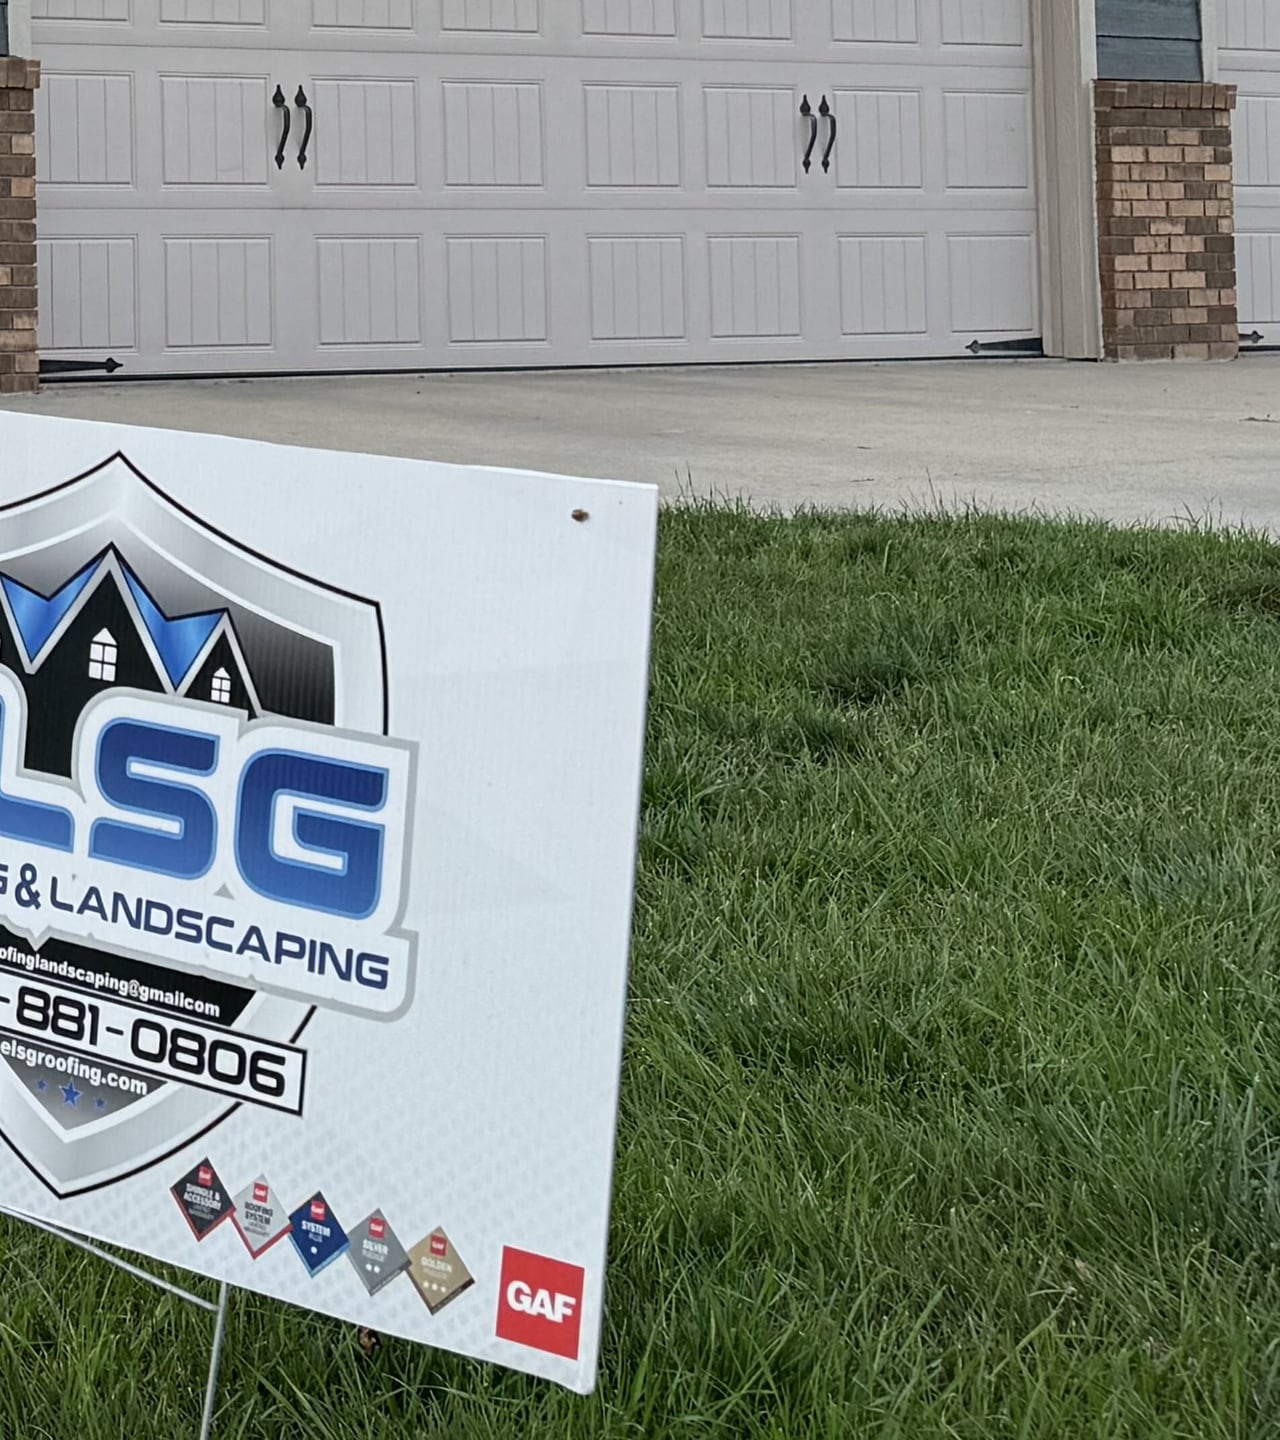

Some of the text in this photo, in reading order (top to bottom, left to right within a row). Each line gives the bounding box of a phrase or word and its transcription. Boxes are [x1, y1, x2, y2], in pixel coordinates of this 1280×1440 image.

[14, 862, 41, 910] &
[49, 876, 389, 990] LANDSCAPING
[0, 1038, 148, 1096] elsgroofing.com
[301, 1220, 331, 1237] SYSTEM
[362, 1238, 389, 1255] SILVER
[507, 1280, 576, 1323] GAF
